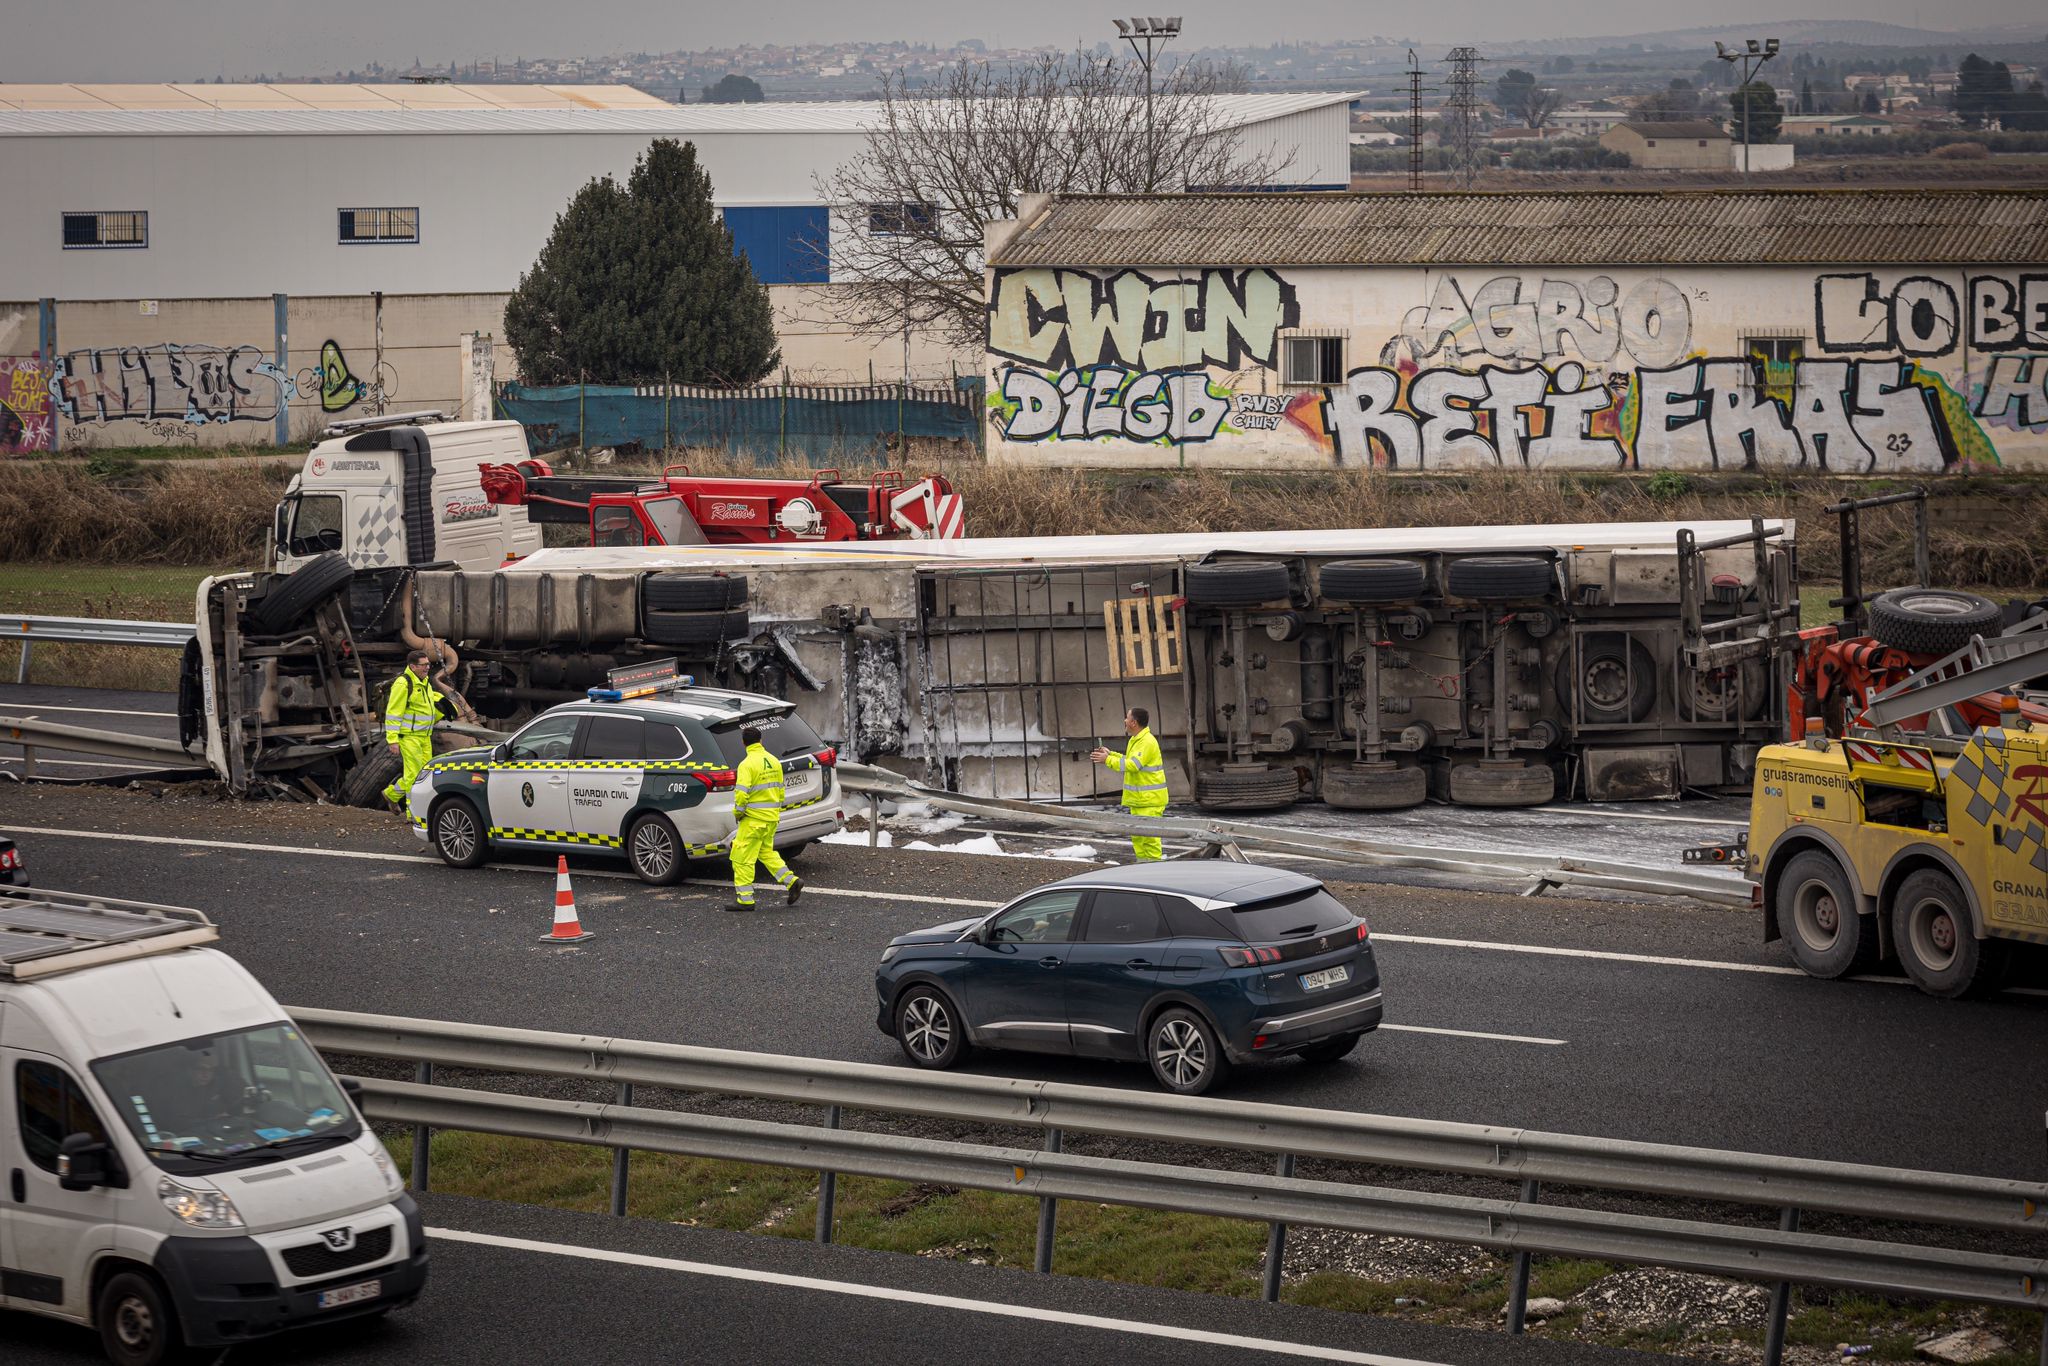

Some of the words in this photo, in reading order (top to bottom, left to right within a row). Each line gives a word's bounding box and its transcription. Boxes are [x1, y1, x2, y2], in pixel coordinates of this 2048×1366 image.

[1886, 433, 1912, 451] 23
[331, 460, 381, 471] ASISTENCIA
[446, 502, 495, 516] Ramos
[711, 503, 756, 520] Ramos
[739, 717, 770, 730] GUARDIA
[769, 715, 785, 723] CIVIL
[573, 788, 609, 799] GUARDIA
[611, 790, 629, 800] CIVIL
[673, 783, 688, 793] 062
[1993, 880, 2048, 900] GRANA
[1306, 972, 1325, 987] 0947
[1328, 968, 1345, 981] MHS
